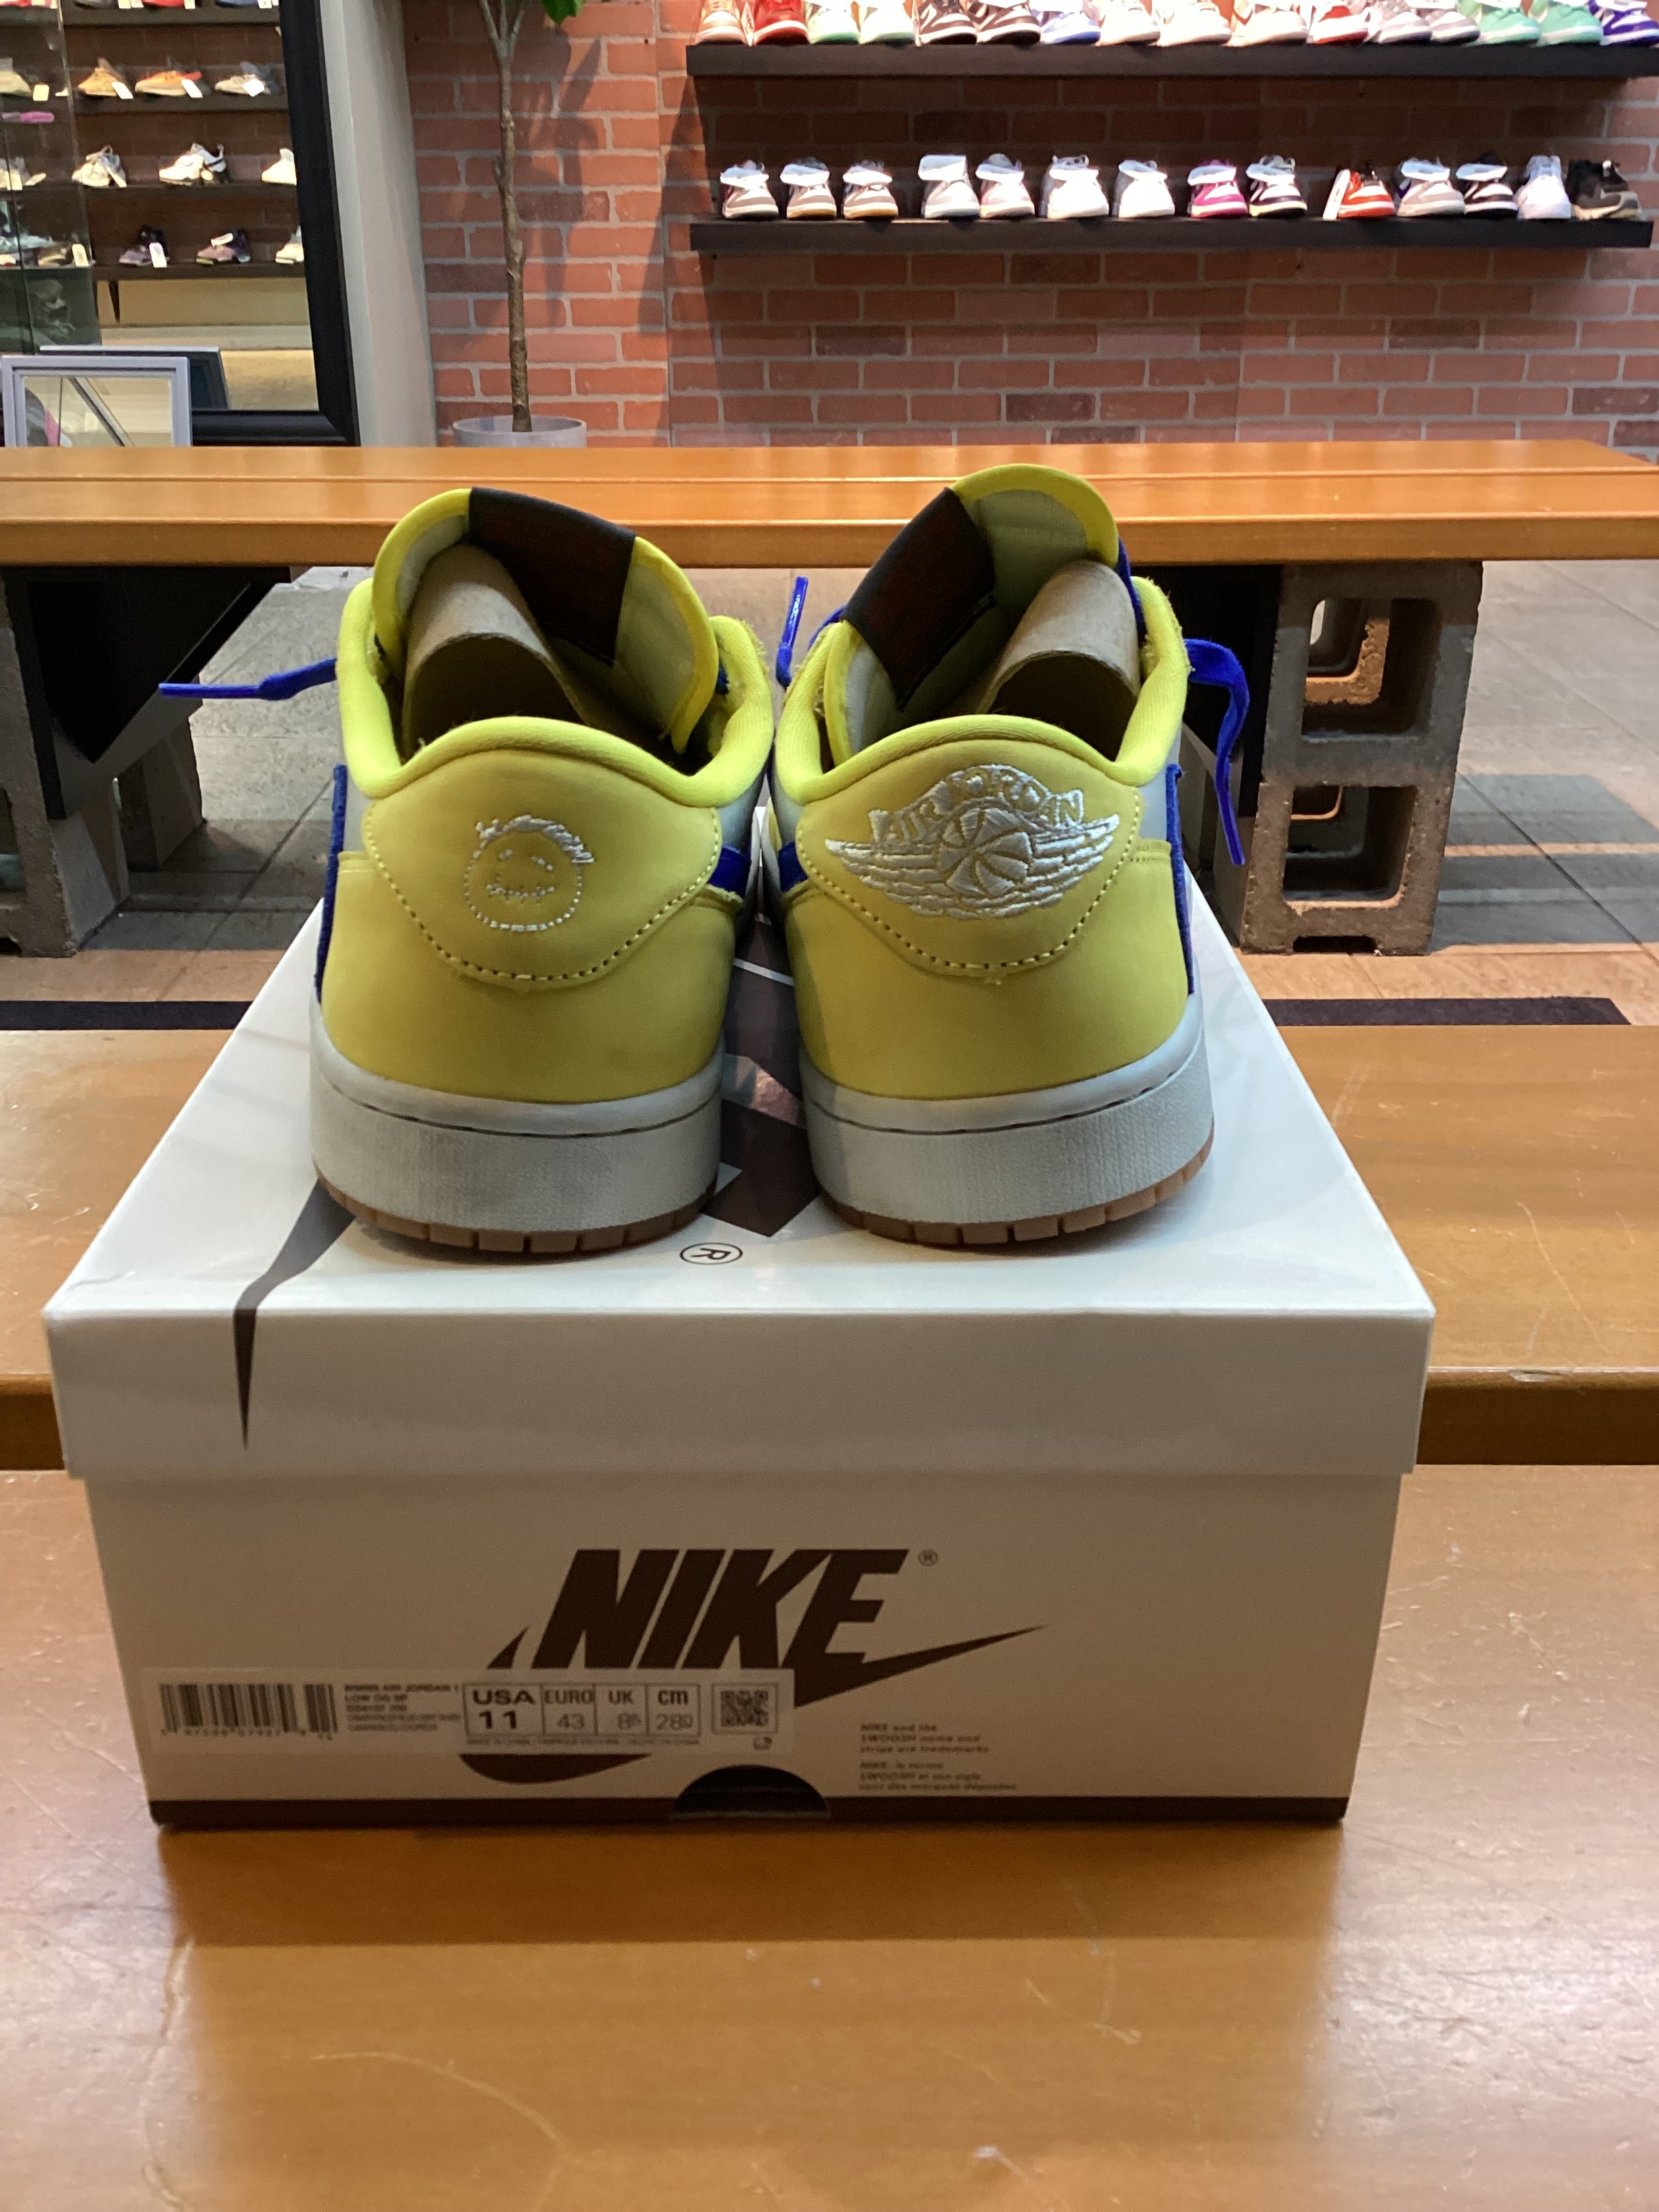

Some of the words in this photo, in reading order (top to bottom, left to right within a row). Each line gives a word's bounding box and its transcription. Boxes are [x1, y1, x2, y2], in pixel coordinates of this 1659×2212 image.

[531, 1549, 909, 1669] NIKE
[472, 1689, 535, 1705] USA
[544, 1689, 594, 1704] EURO
[609, 1689, 634, 1704] UK
[657, 1689, 689, 1705] cm
[478, 1711, 517, 1729] 11
[557, 1713, 585, 1730] 43
